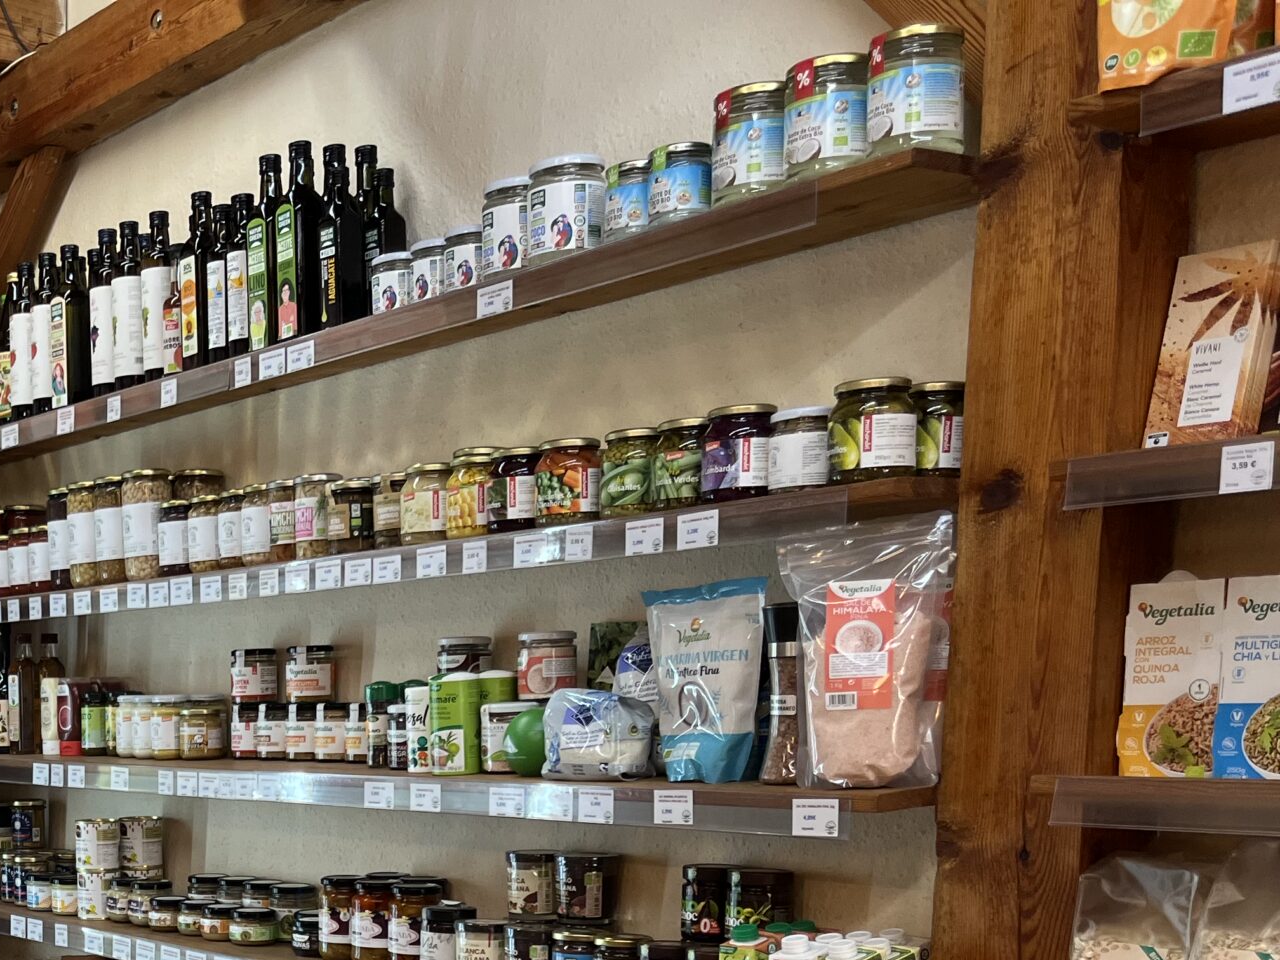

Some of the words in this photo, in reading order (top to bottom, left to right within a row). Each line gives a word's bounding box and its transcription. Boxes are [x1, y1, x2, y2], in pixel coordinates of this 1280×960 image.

[1195, 342, 1222, 355] VIVANI
[1230, 461, 1249, 470] 3,59
[838, 583, 883, 597] Vegetalia
[832, 604, 887, 616] HIMALAYA
[1141, 603, 1216, 626] Vegetalia
[1136, 635, 1177, 646] ARROZ
[703, 649, 750, 663] VIRGEN
[1135, 646, 1193, 657] INTEGRAL
[1232, 652, 1262, 662] CHIA
[1133, 663, 1181, 674] QUINOA
[1132, 674, 1166, 685] ROJA
